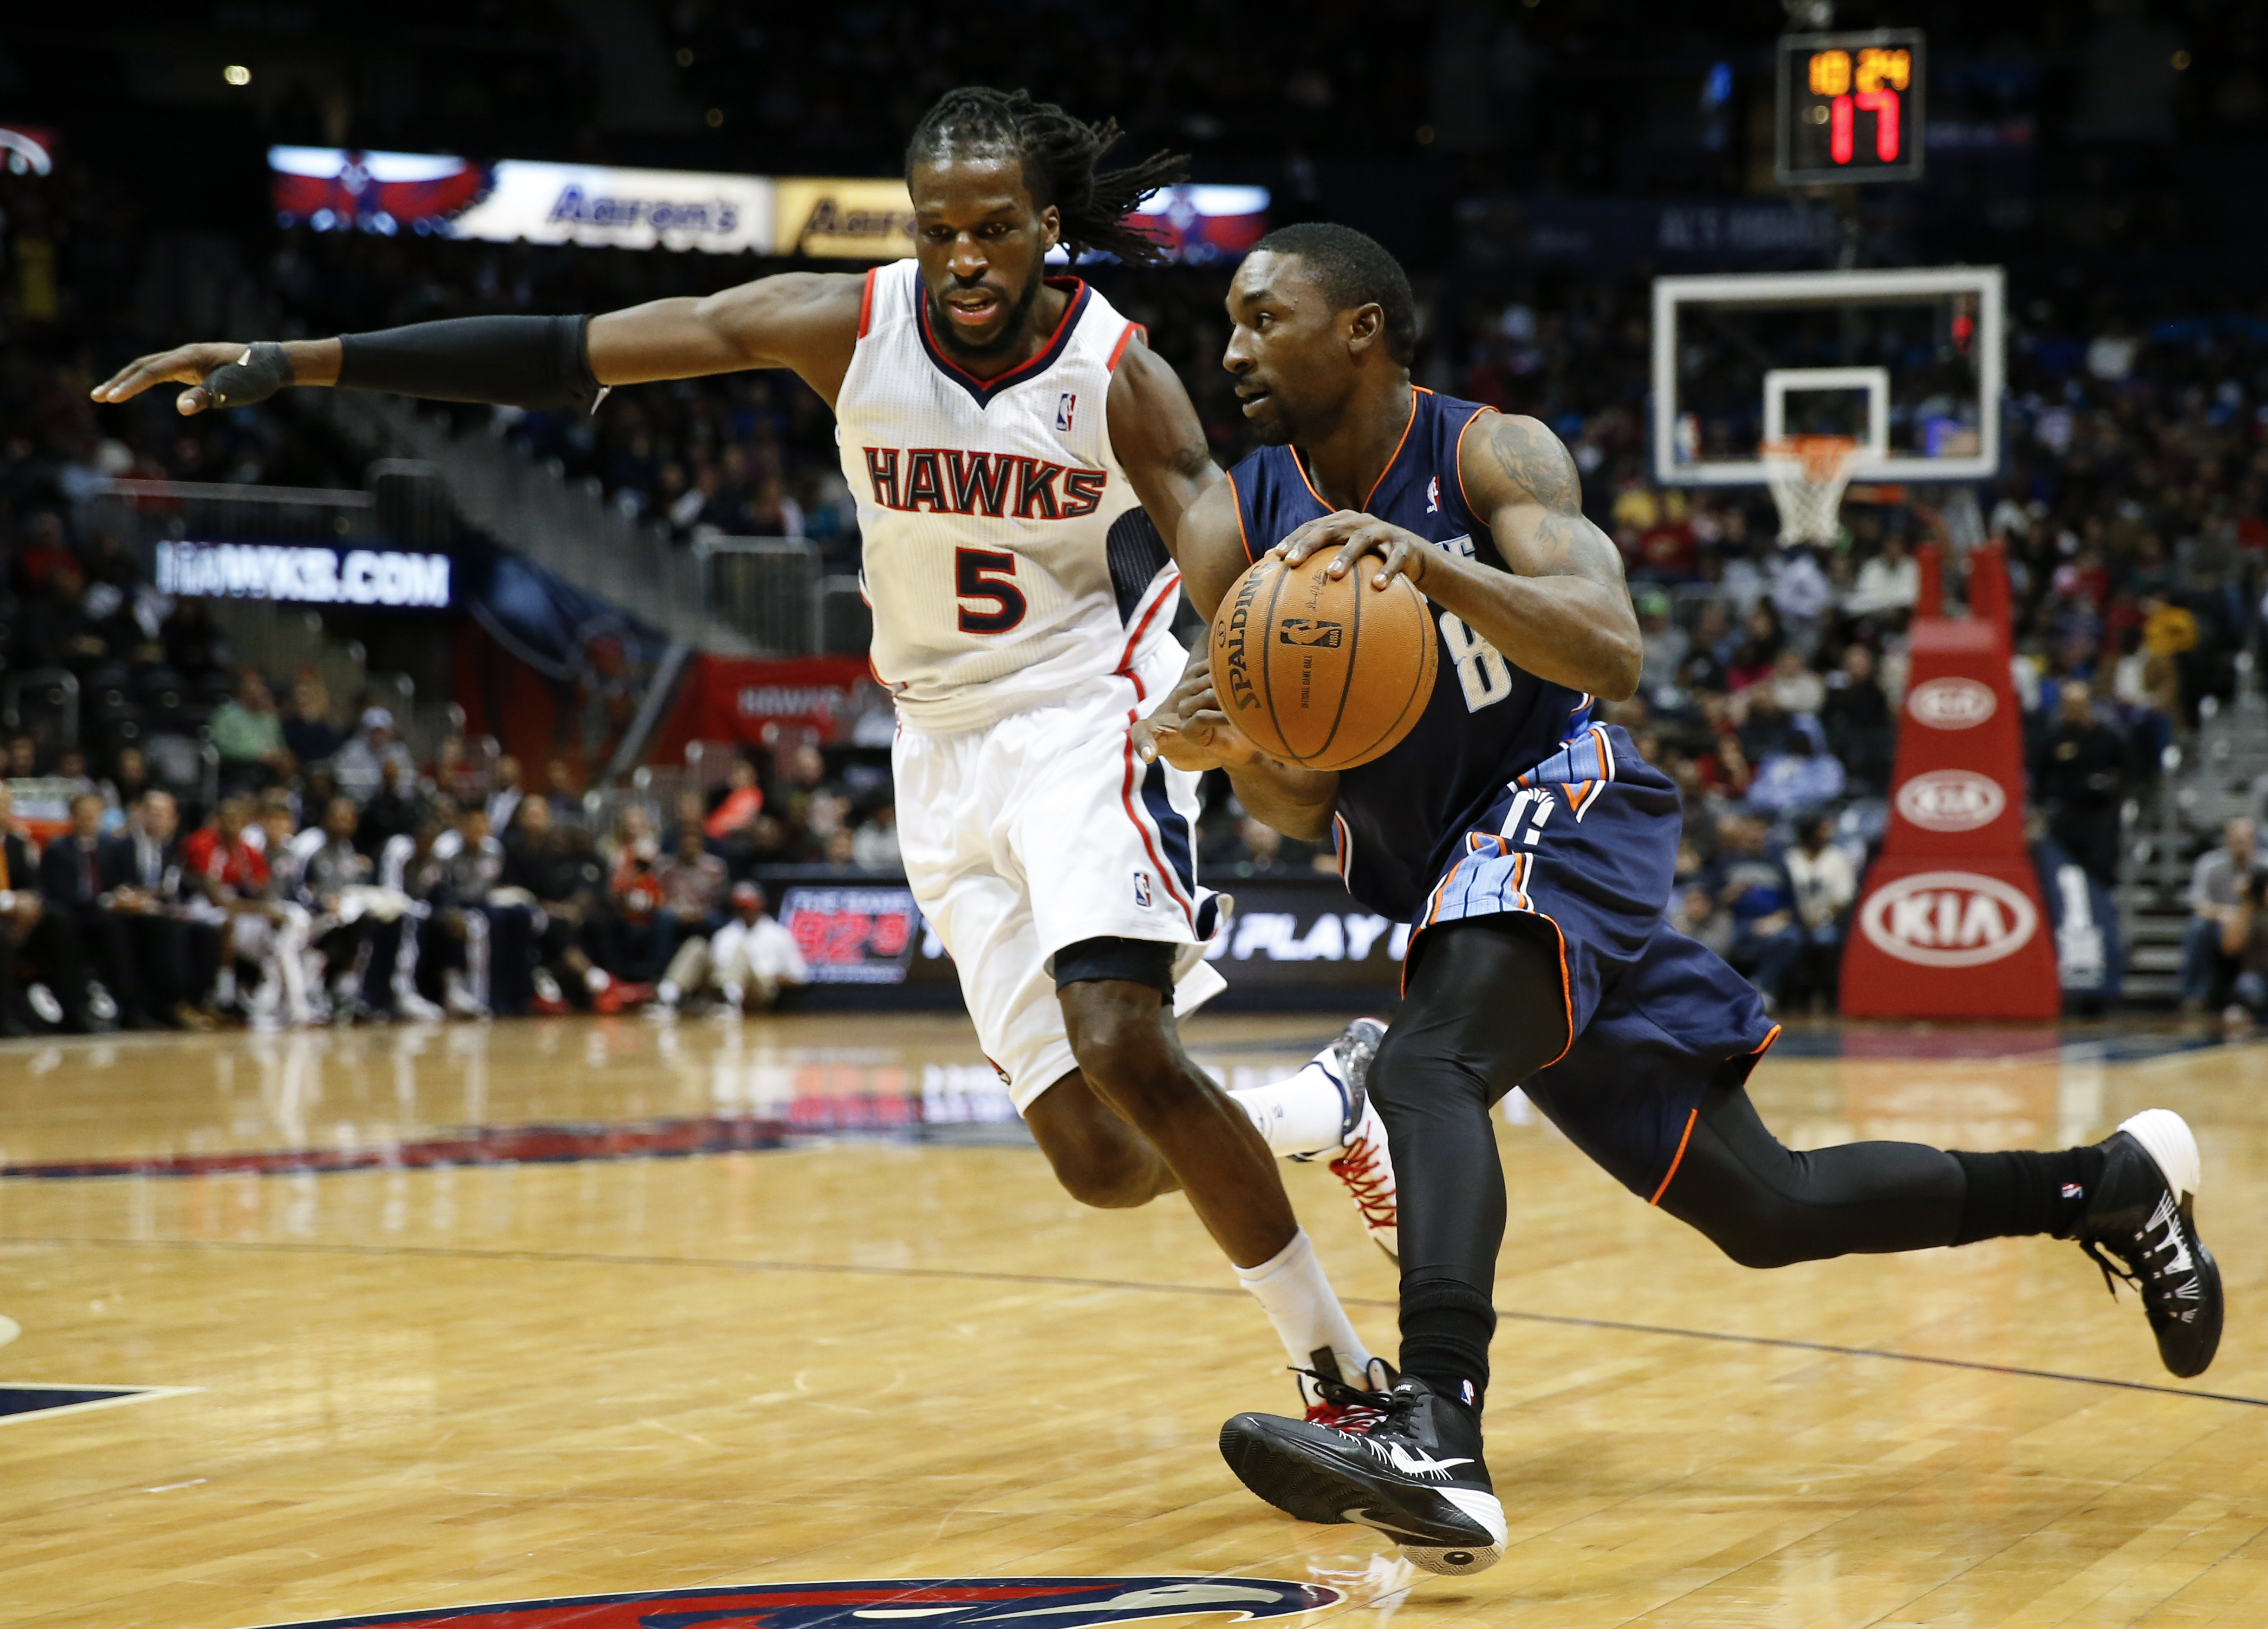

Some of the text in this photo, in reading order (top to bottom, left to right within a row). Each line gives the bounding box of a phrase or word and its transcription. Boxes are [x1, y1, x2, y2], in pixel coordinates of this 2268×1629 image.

[1831, 89, 1900, 165] 17
[547, 184, 738, 234] Aaron's
[863, 447, 1107, 520] HAWKS
[955, 546, 1027, 634] 5
[1228, 563, 1274, 711] SPALDING
[1328, 630, 1340, 646] NBA
[1301, 654, 1313, 709] OFFICIAL GAME BALL
[1891, 891, 2008, 946] KIA
